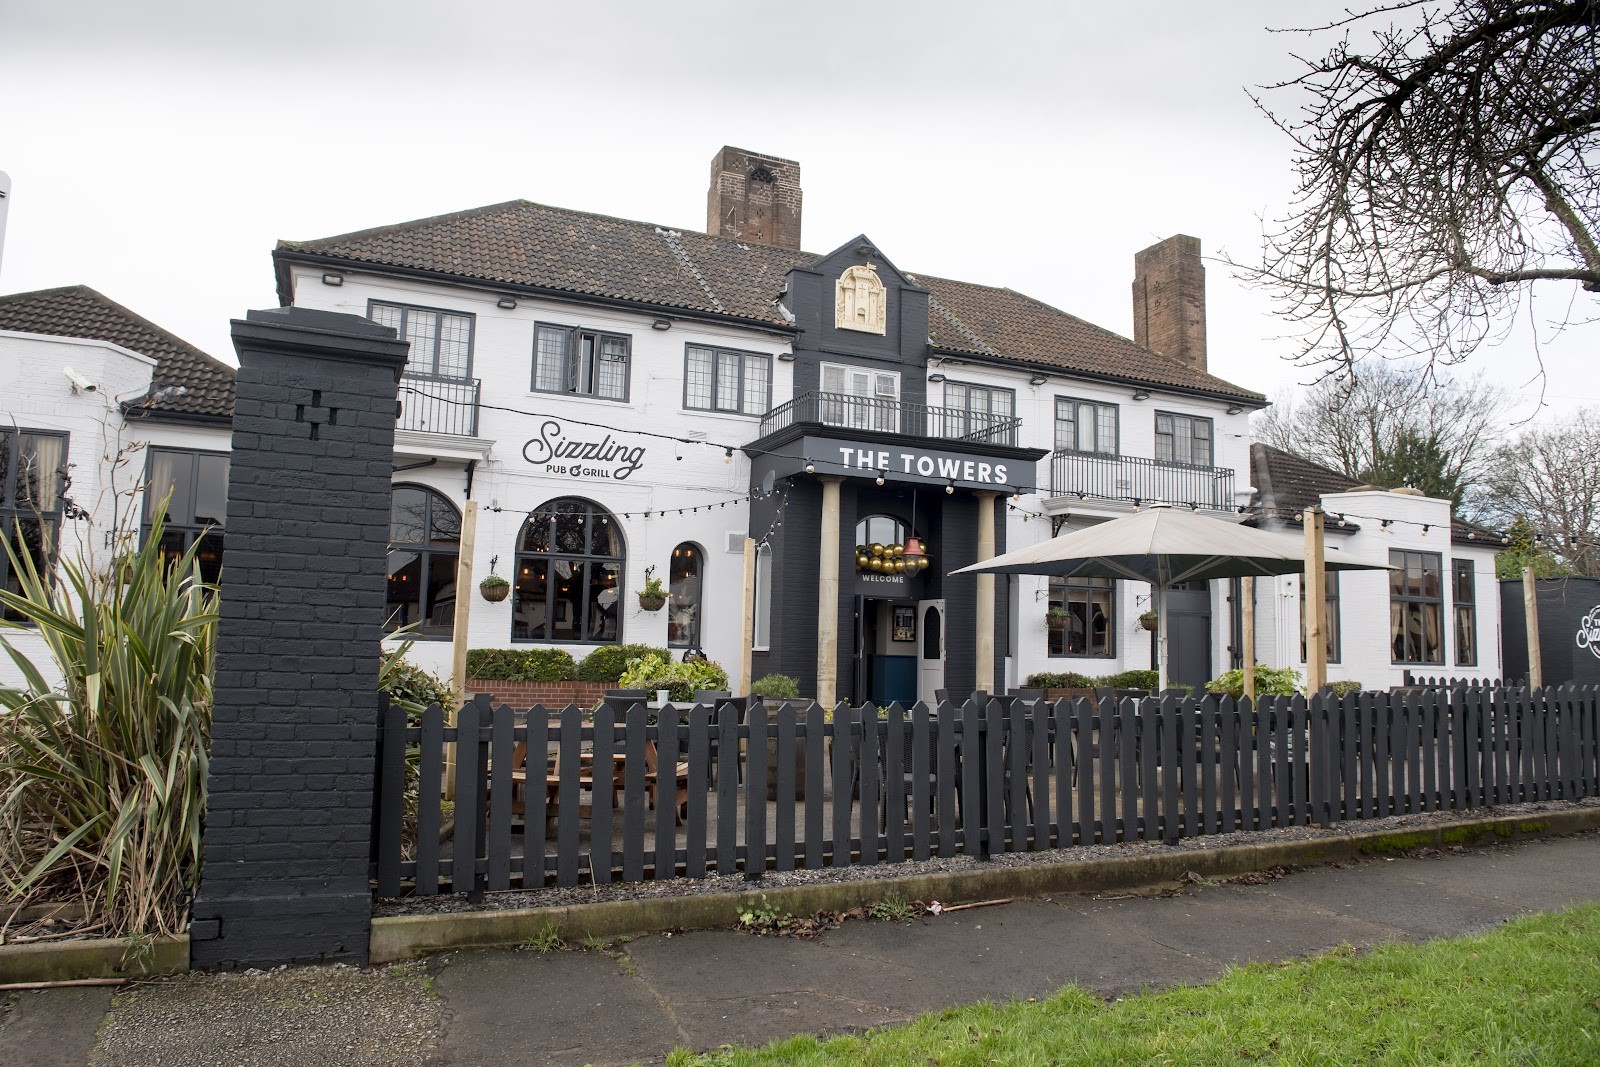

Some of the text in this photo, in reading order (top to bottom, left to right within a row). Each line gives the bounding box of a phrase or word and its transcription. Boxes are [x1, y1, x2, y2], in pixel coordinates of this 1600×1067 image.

[522, 420, 646, 480] Sizzling
[546, 464, 567, 474] PUB
[582, 467, 610, 478] GRILL
[839, 447, 1007, 484] THE TOWERS
[862, 574, 904, 584] WELCOME
